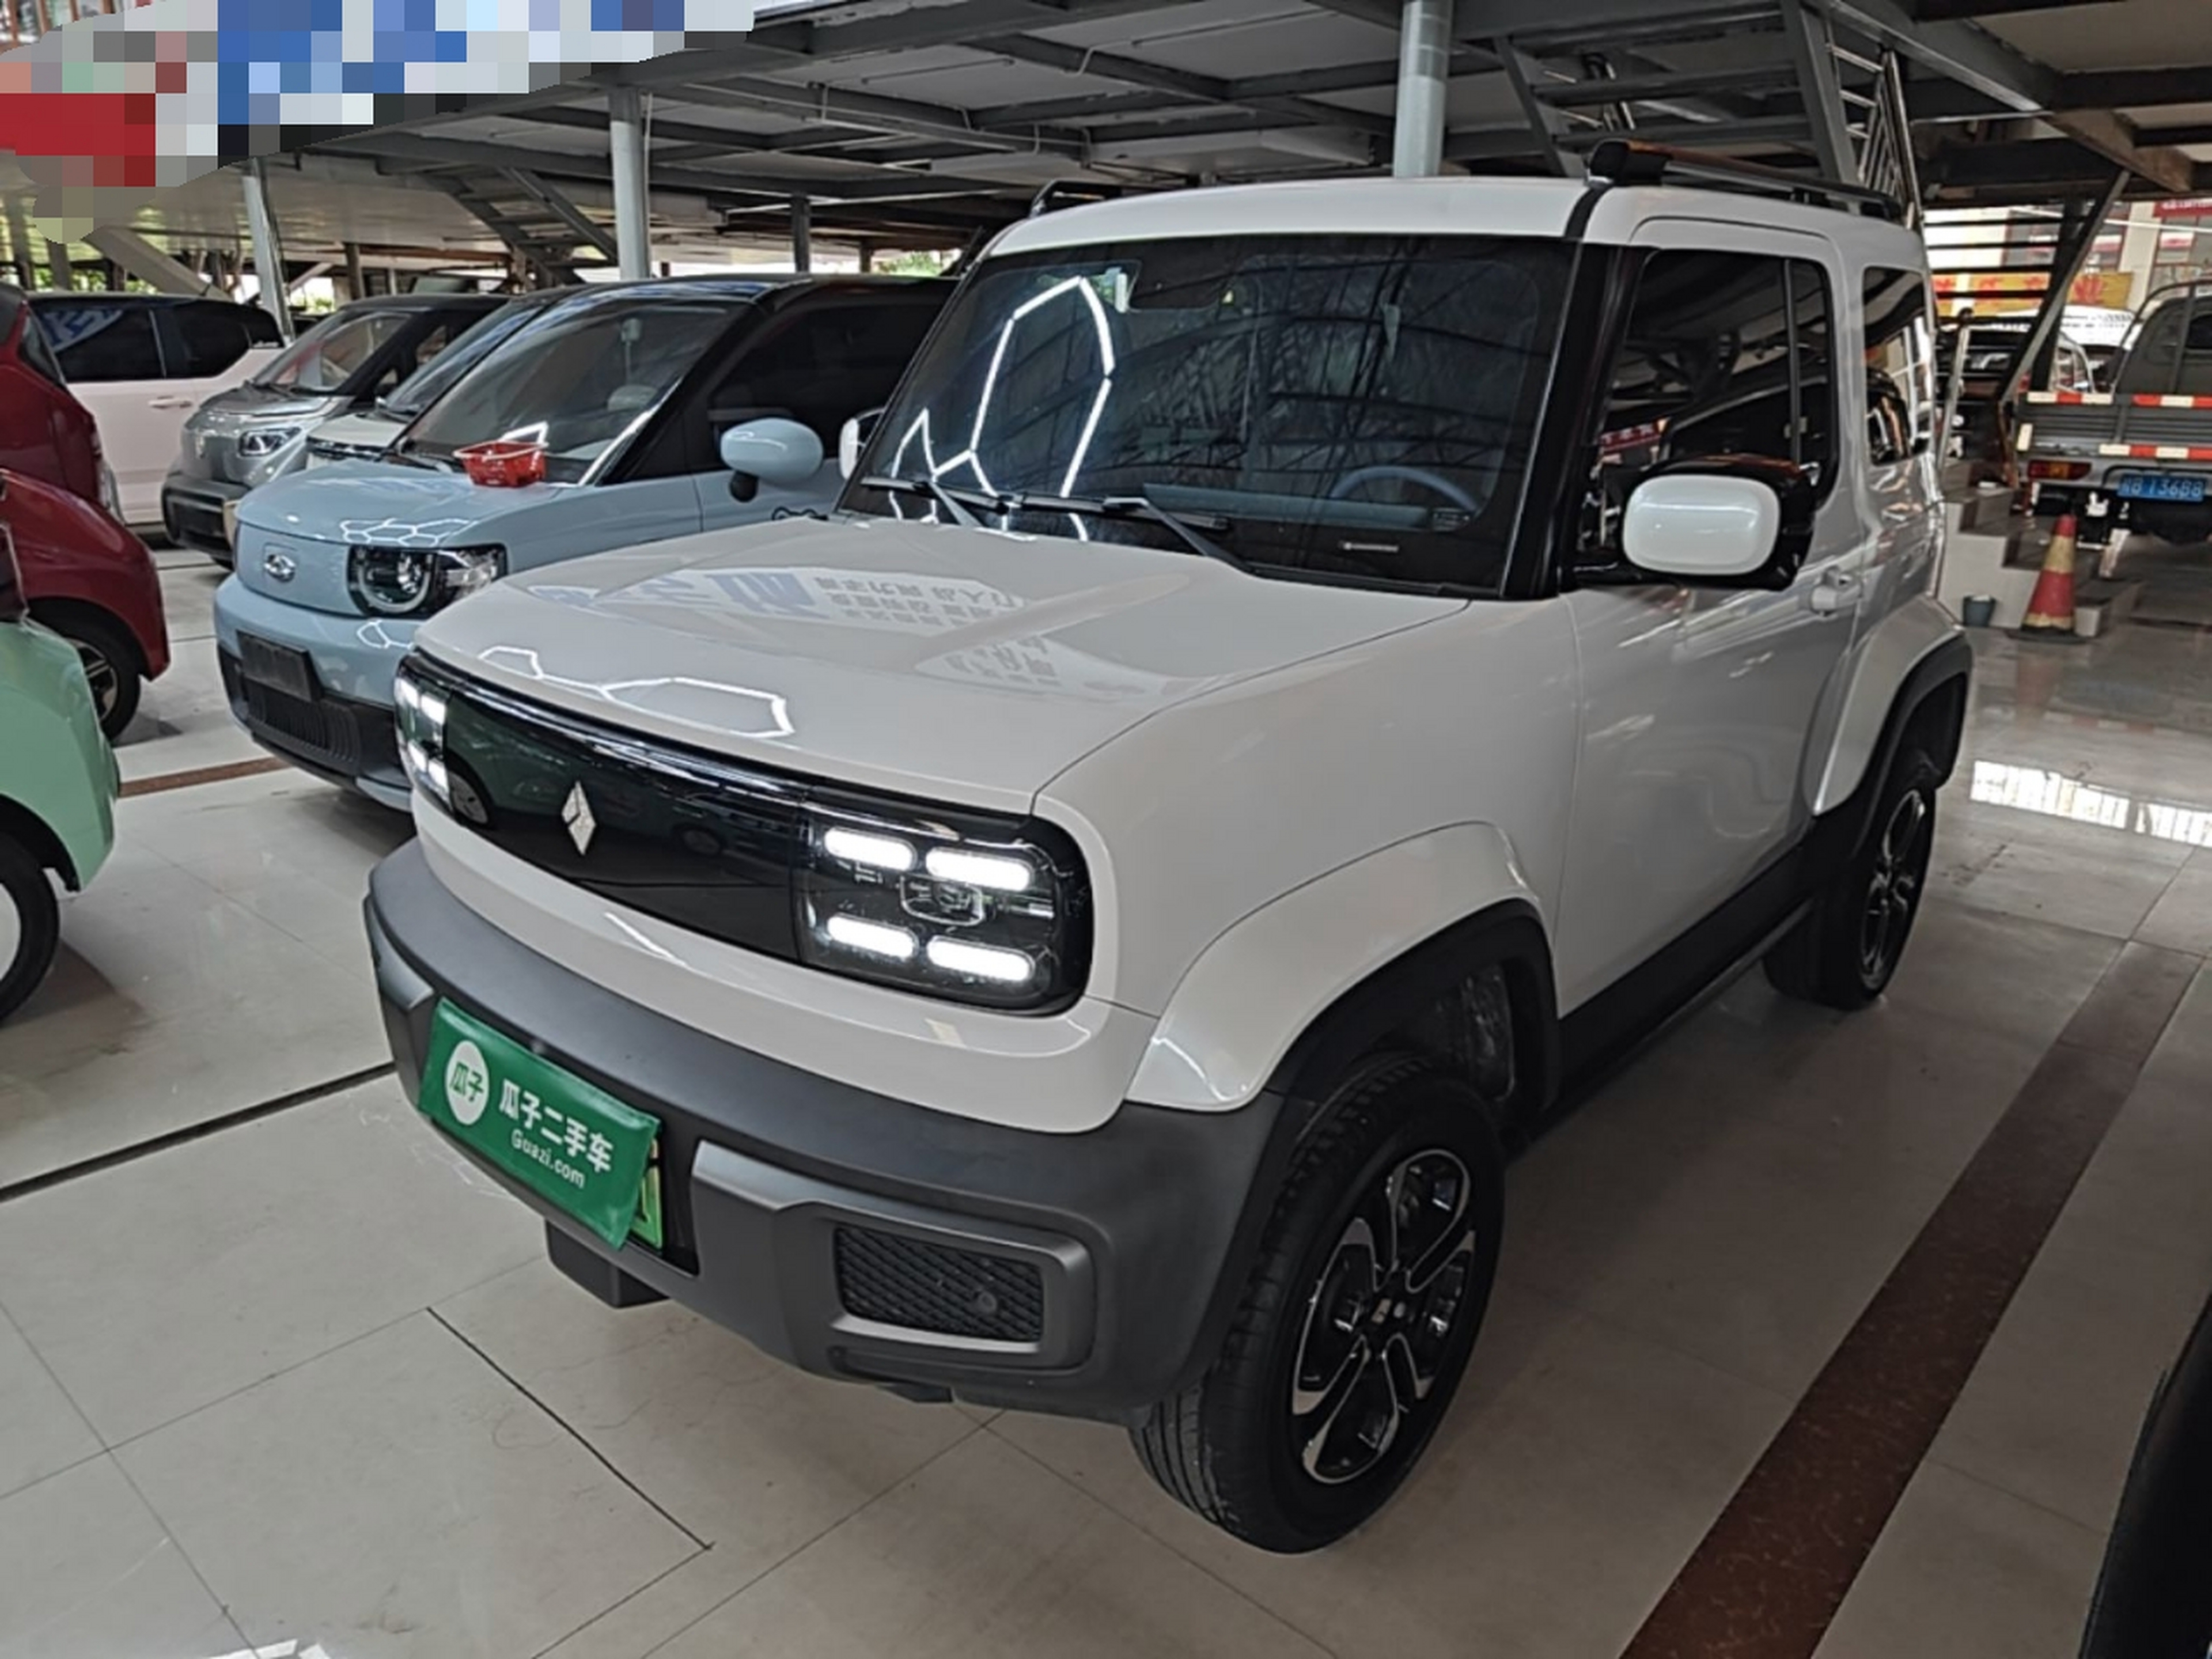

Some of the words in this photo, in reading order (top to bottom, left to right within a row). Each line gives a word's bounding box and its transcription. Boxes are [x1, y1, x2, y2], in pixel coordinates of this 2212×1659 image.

[449, 1061, 484, 1103] 瓜子
[499, 1077, 614, 1173] 瓜子二手车
[511, 1128, 586, 1189] Guazi.com
